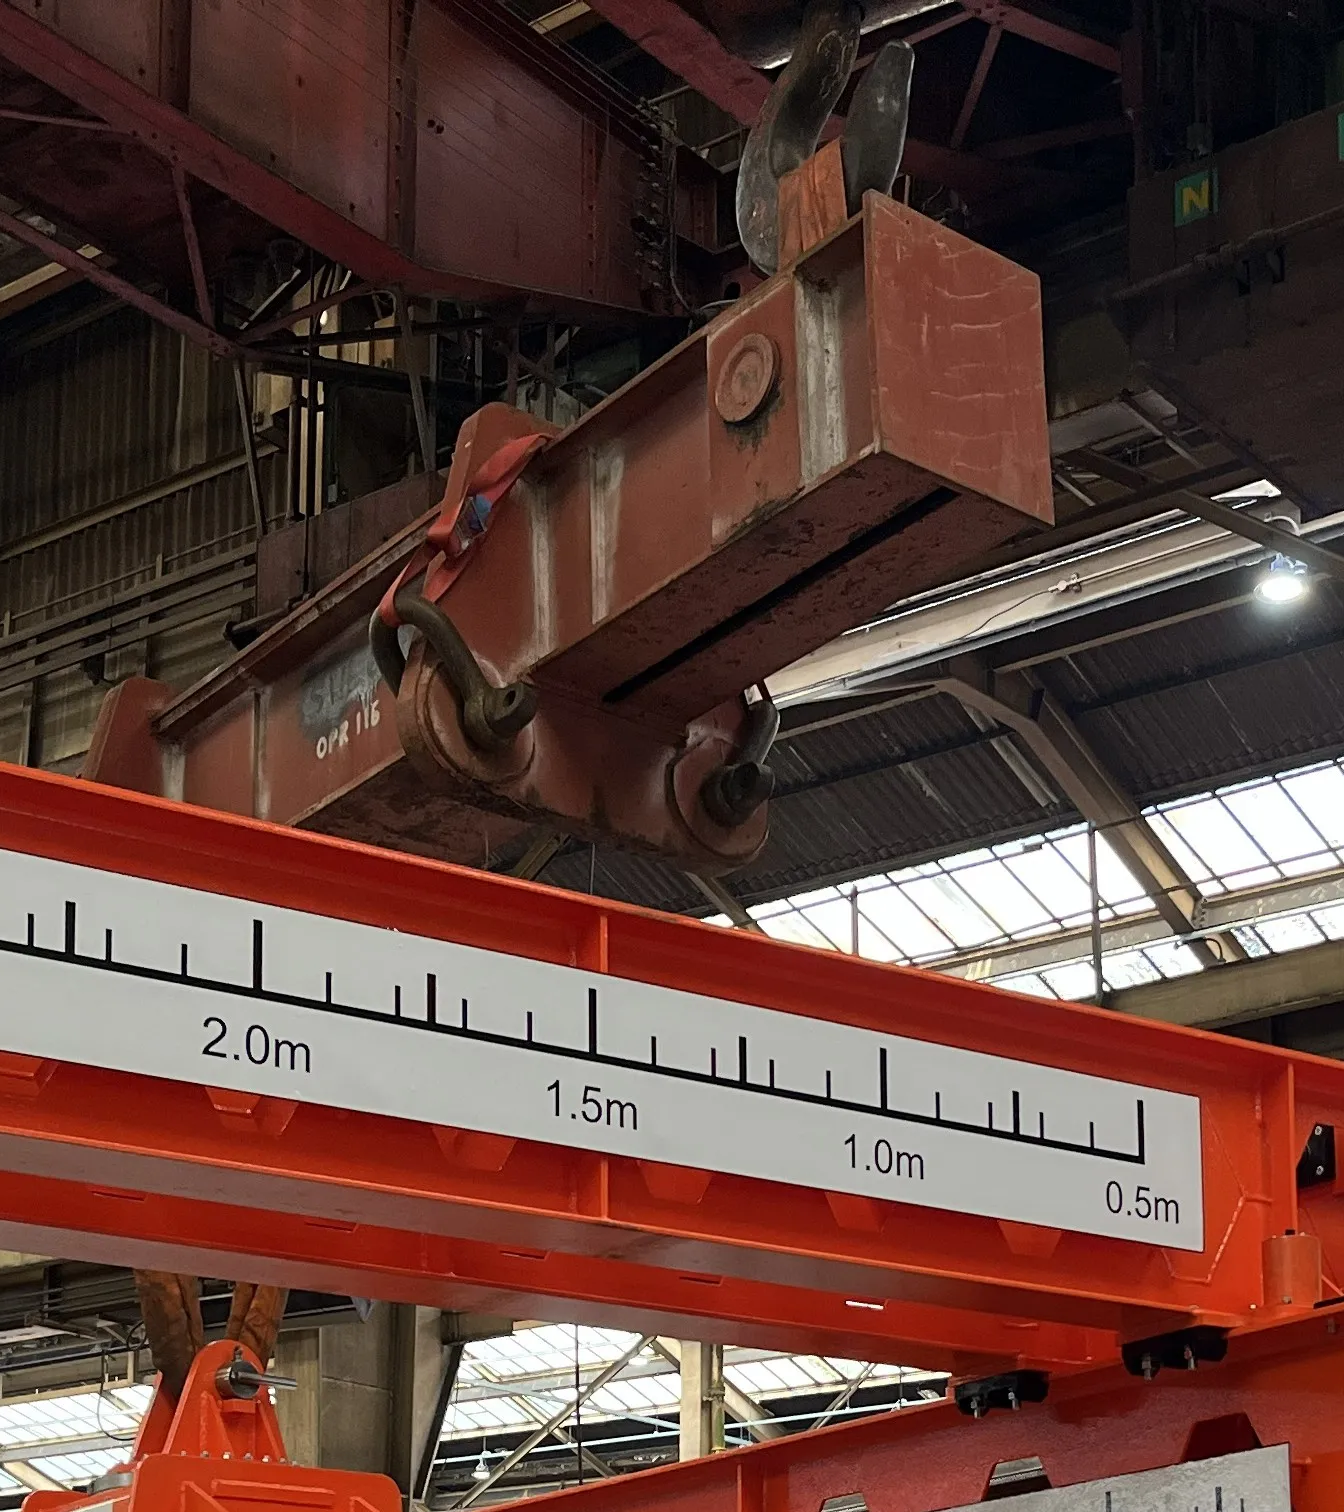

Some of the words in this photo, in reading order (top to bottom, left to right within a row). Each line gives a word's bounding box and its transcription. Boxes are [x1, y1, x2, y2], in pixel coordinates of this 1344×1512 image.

[1181, 178, 1210, 217] N
[201, 1016, 312, 1074] 2.0m
[546, 1079, 639, 1131] 1.5m
[844, 1133, 925, 1180] 1.0m
[1106, 1180, 1181, 1225] 0.5m
